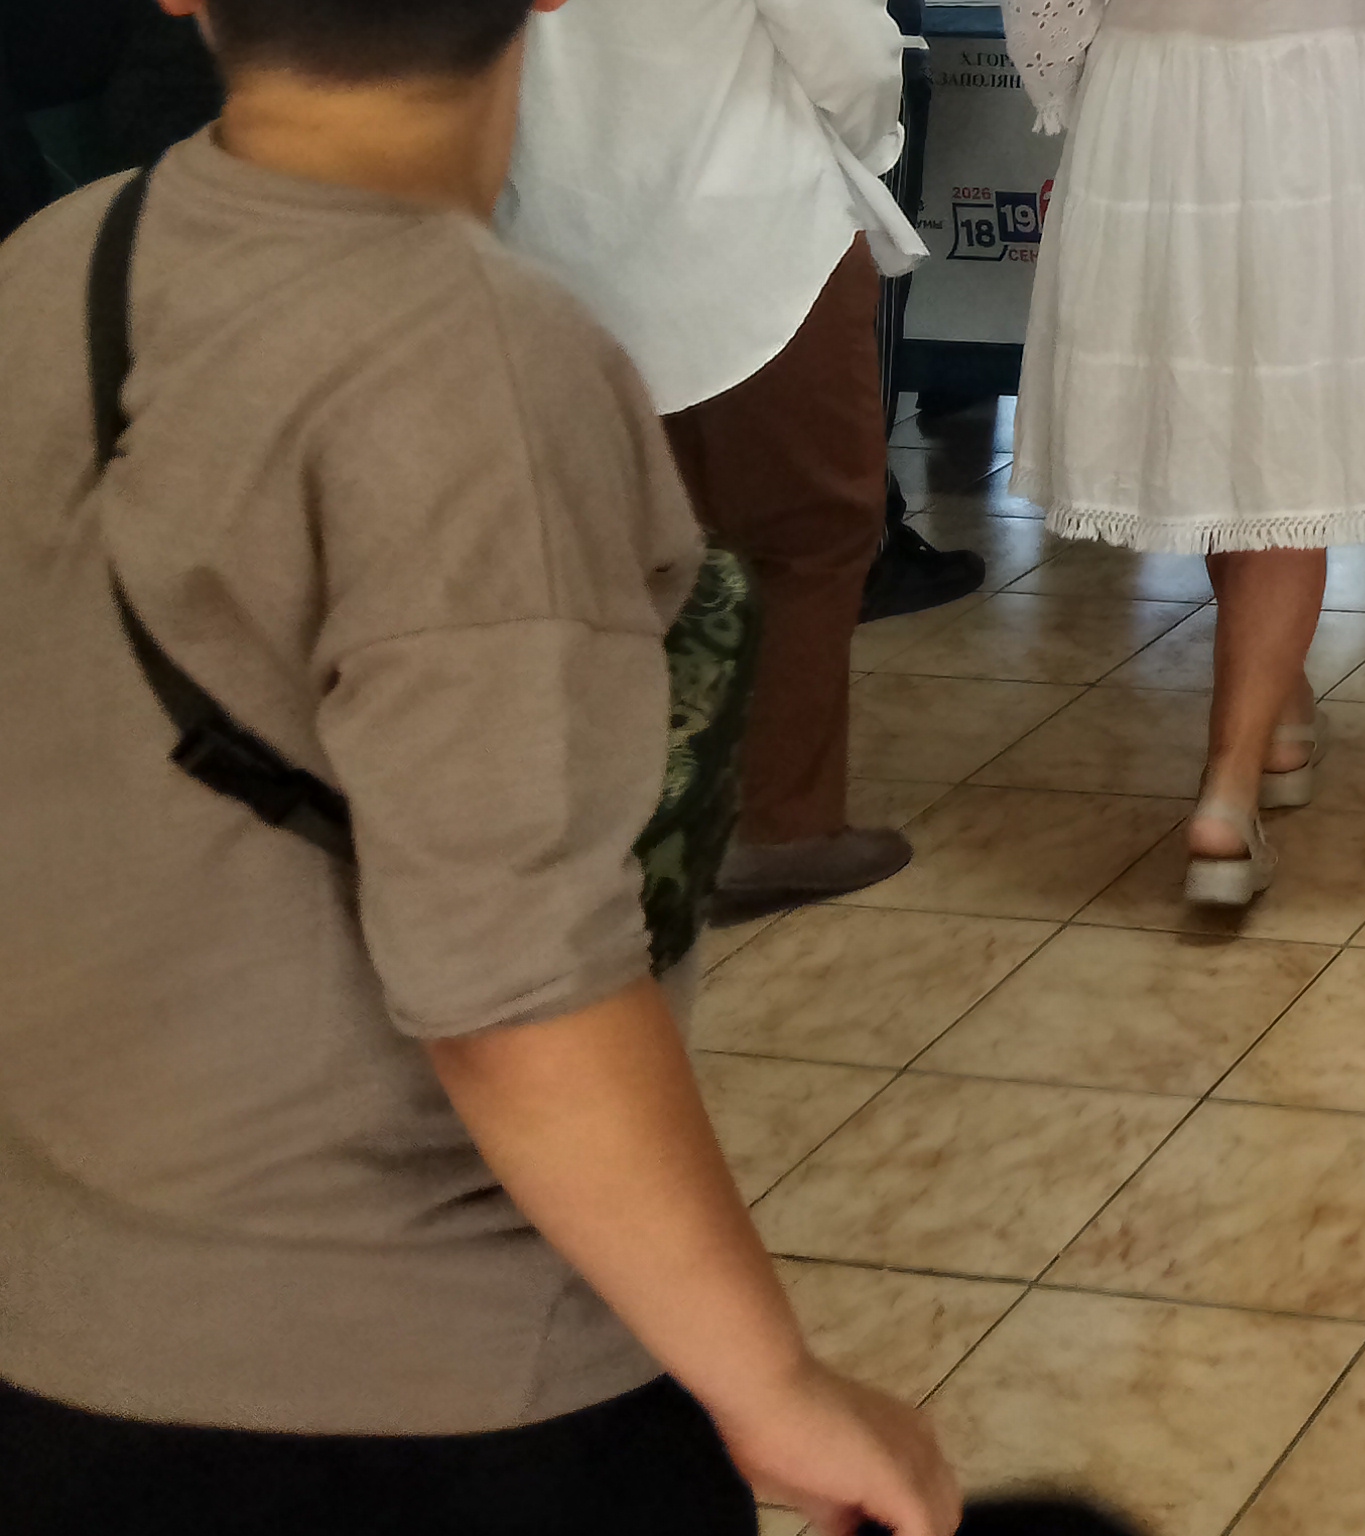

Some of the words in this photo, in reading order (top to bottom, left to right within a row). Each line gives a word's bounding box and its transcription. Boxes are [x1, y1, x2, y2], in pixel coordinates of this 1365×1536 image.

[952, 186, 992, 200] 2026
[960, 219, 996, 248] 18
[1000, 204, 1035, 234] 19
